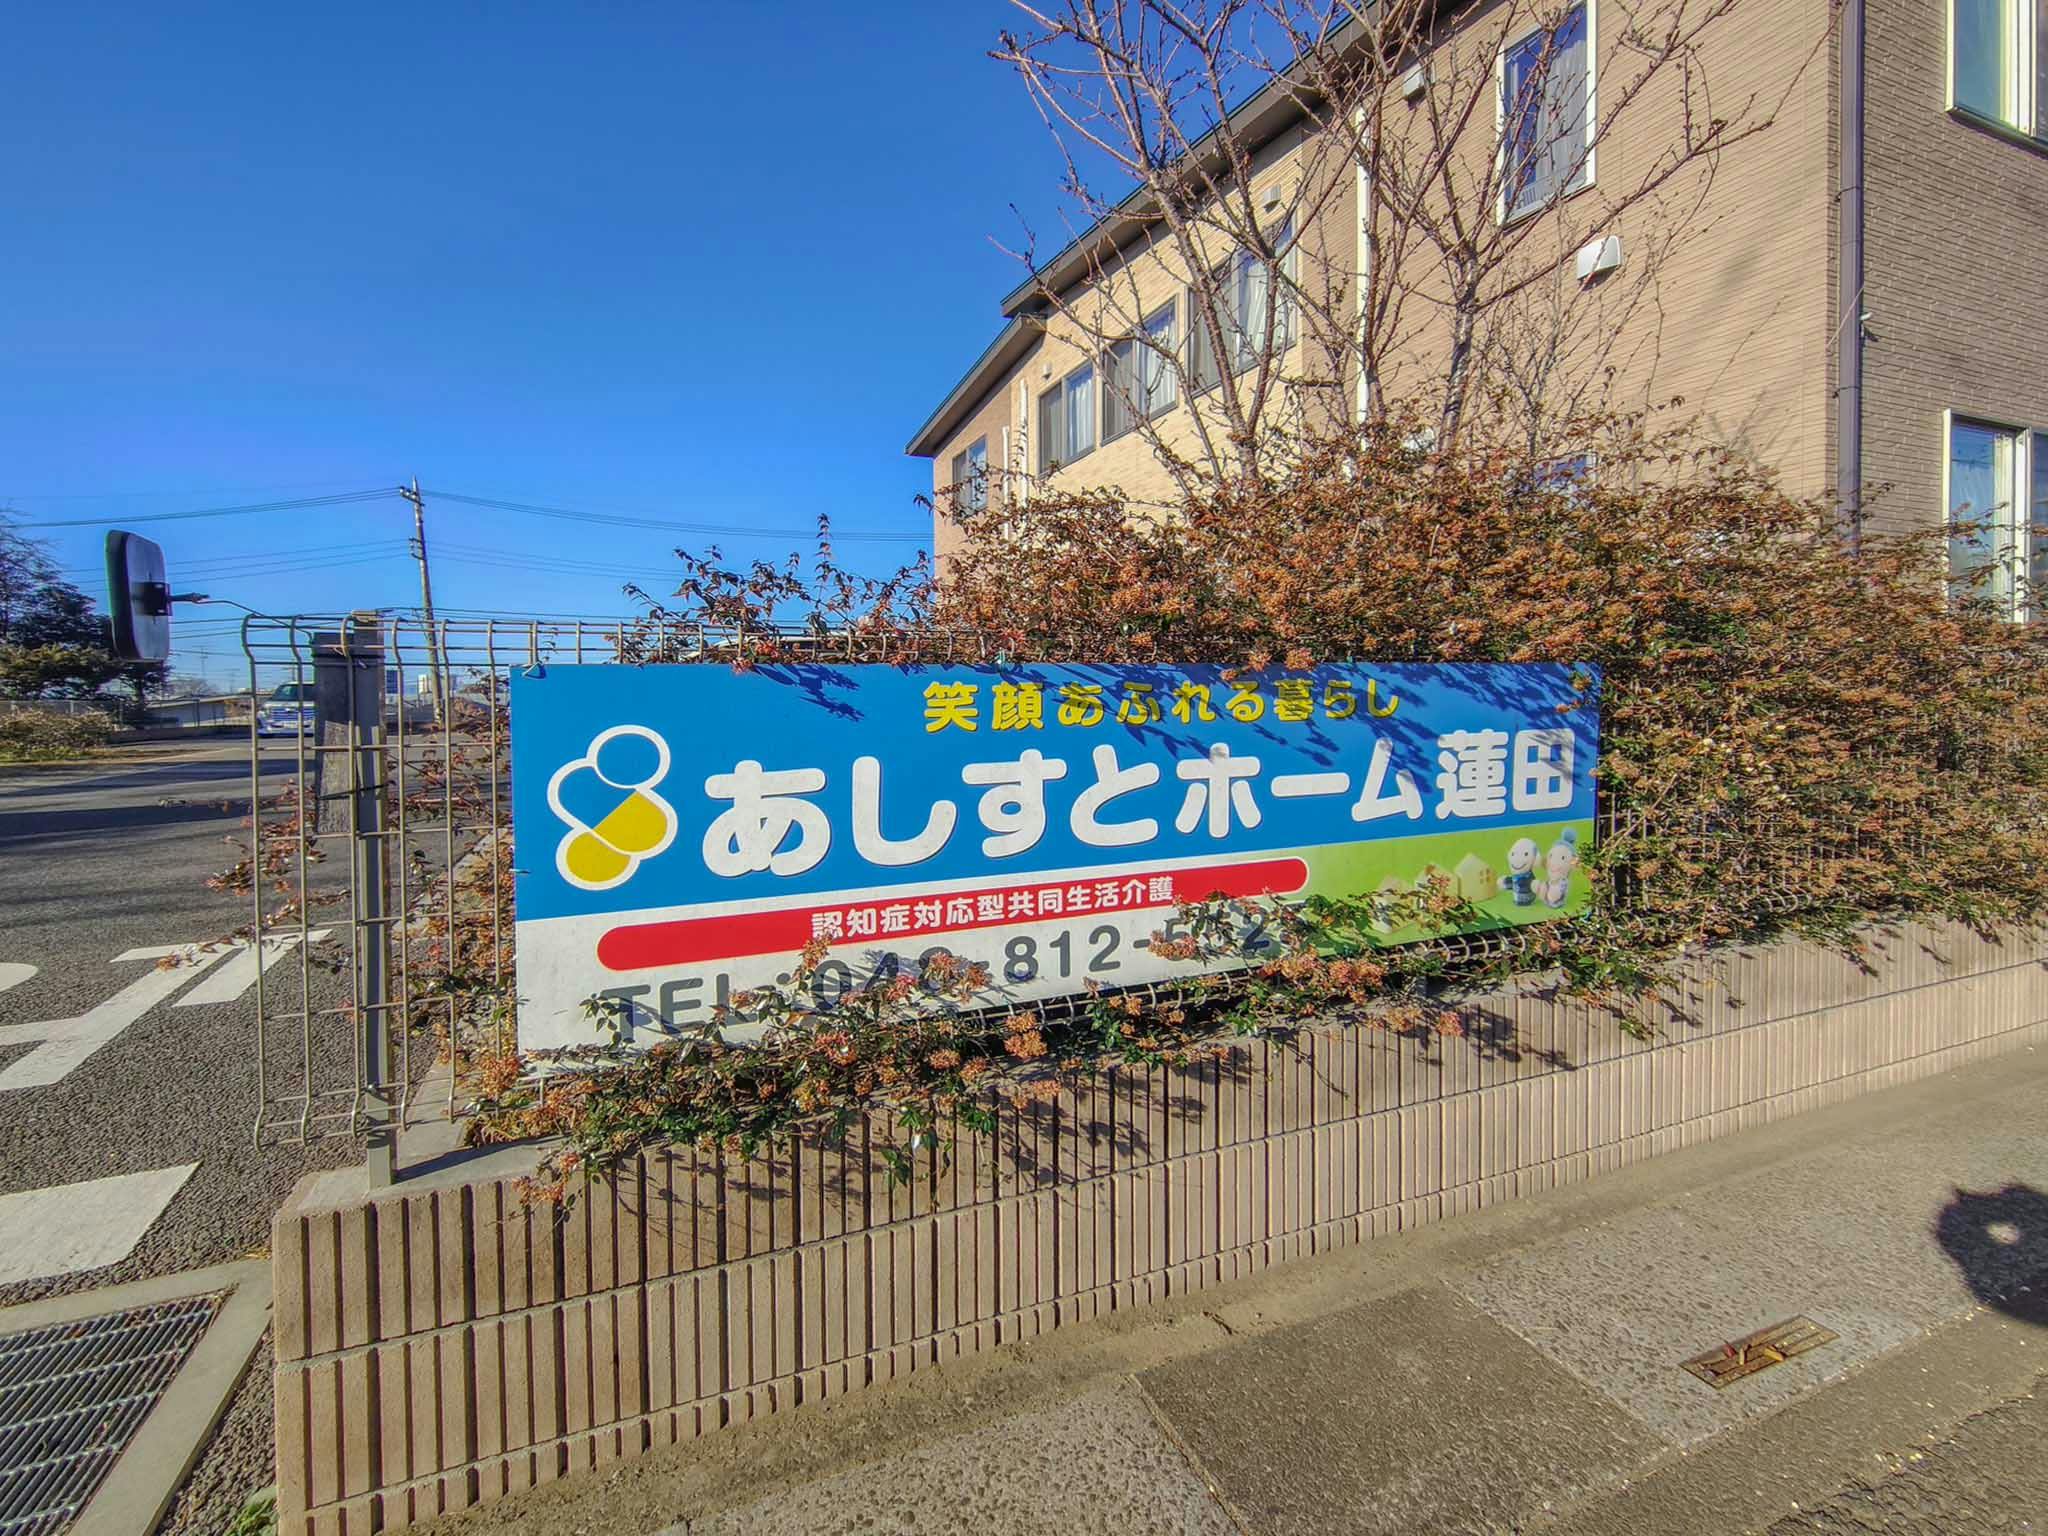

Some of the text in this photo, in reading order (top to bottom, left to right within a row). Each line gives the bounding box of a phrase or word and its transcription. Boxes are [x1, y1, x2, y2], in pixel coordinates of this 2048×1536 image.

[923, 678, 1400, 732] 笑顔あふれる暮らし
[701, 727, 1577, 876] あしすとホーム蓮田
[811, 876, 1174, 939] 認知症対応型共同生活介護
